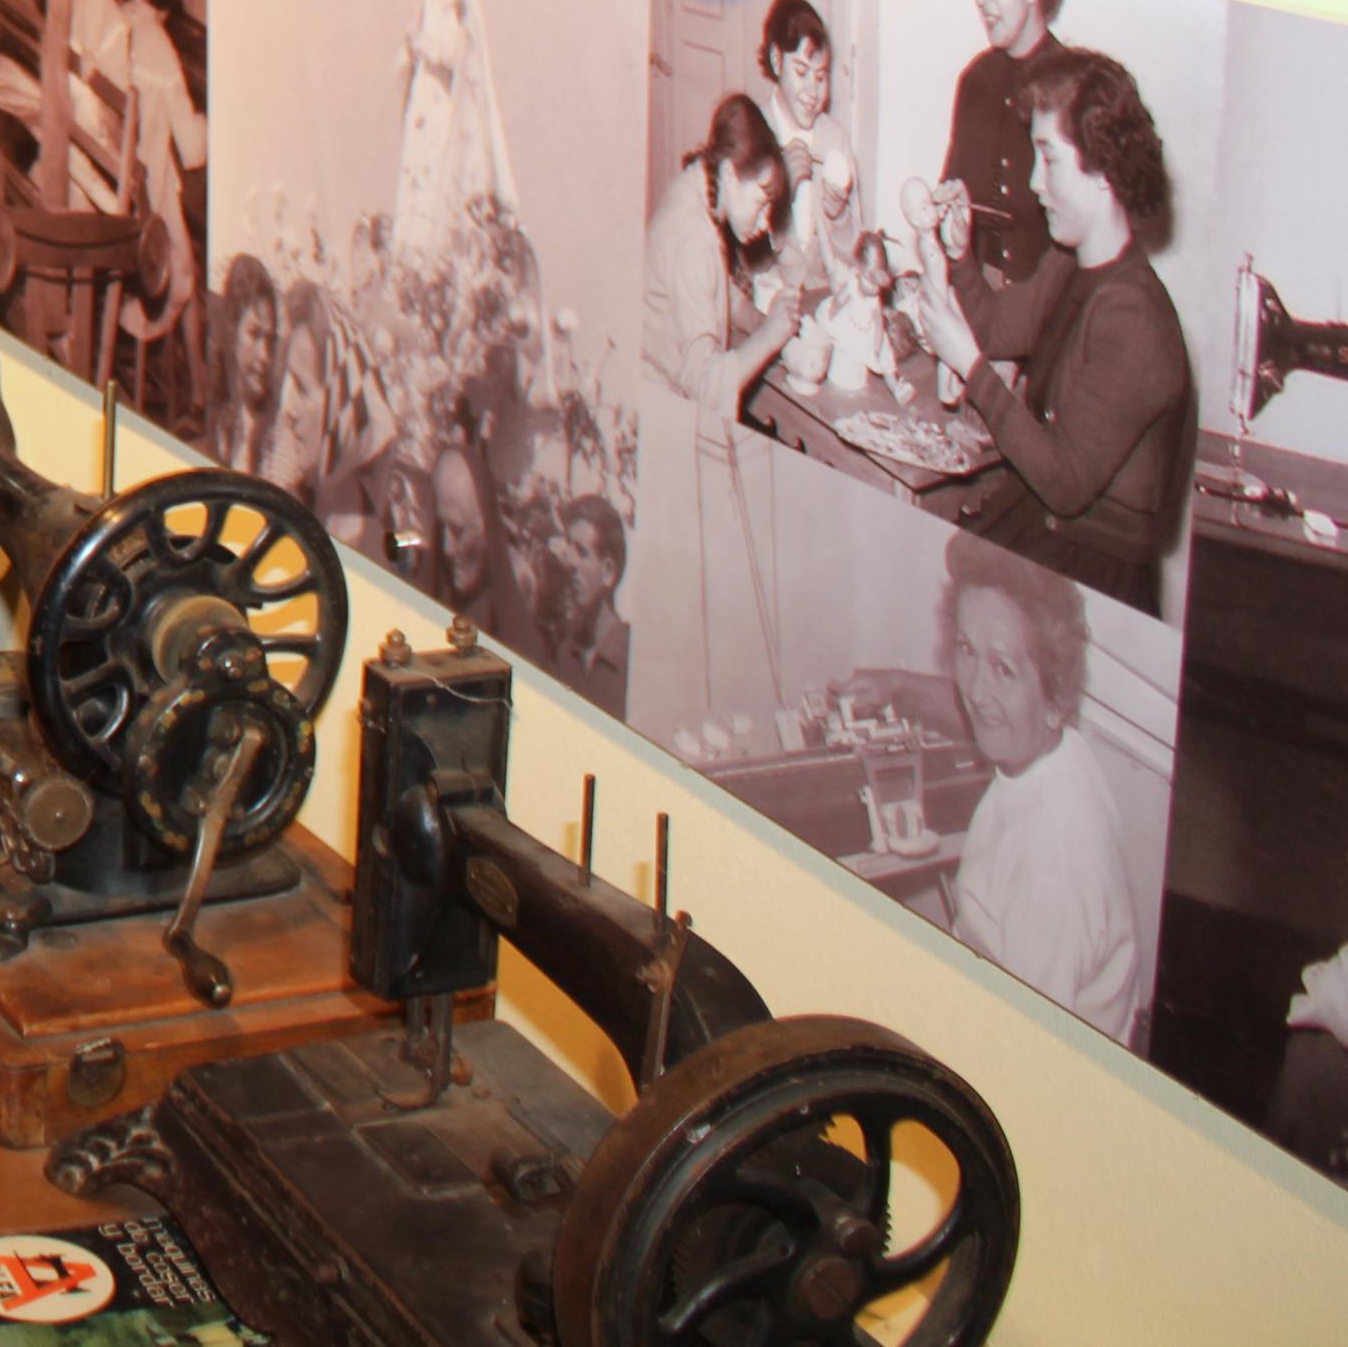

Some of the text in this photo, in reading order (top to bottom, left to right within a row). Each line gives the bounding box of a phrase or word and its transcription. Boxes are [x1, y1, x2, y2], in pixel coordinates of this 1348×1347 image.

[98, 1224, 176, 1308] y bordar
[124, 1221, 195, 1305] de coser
